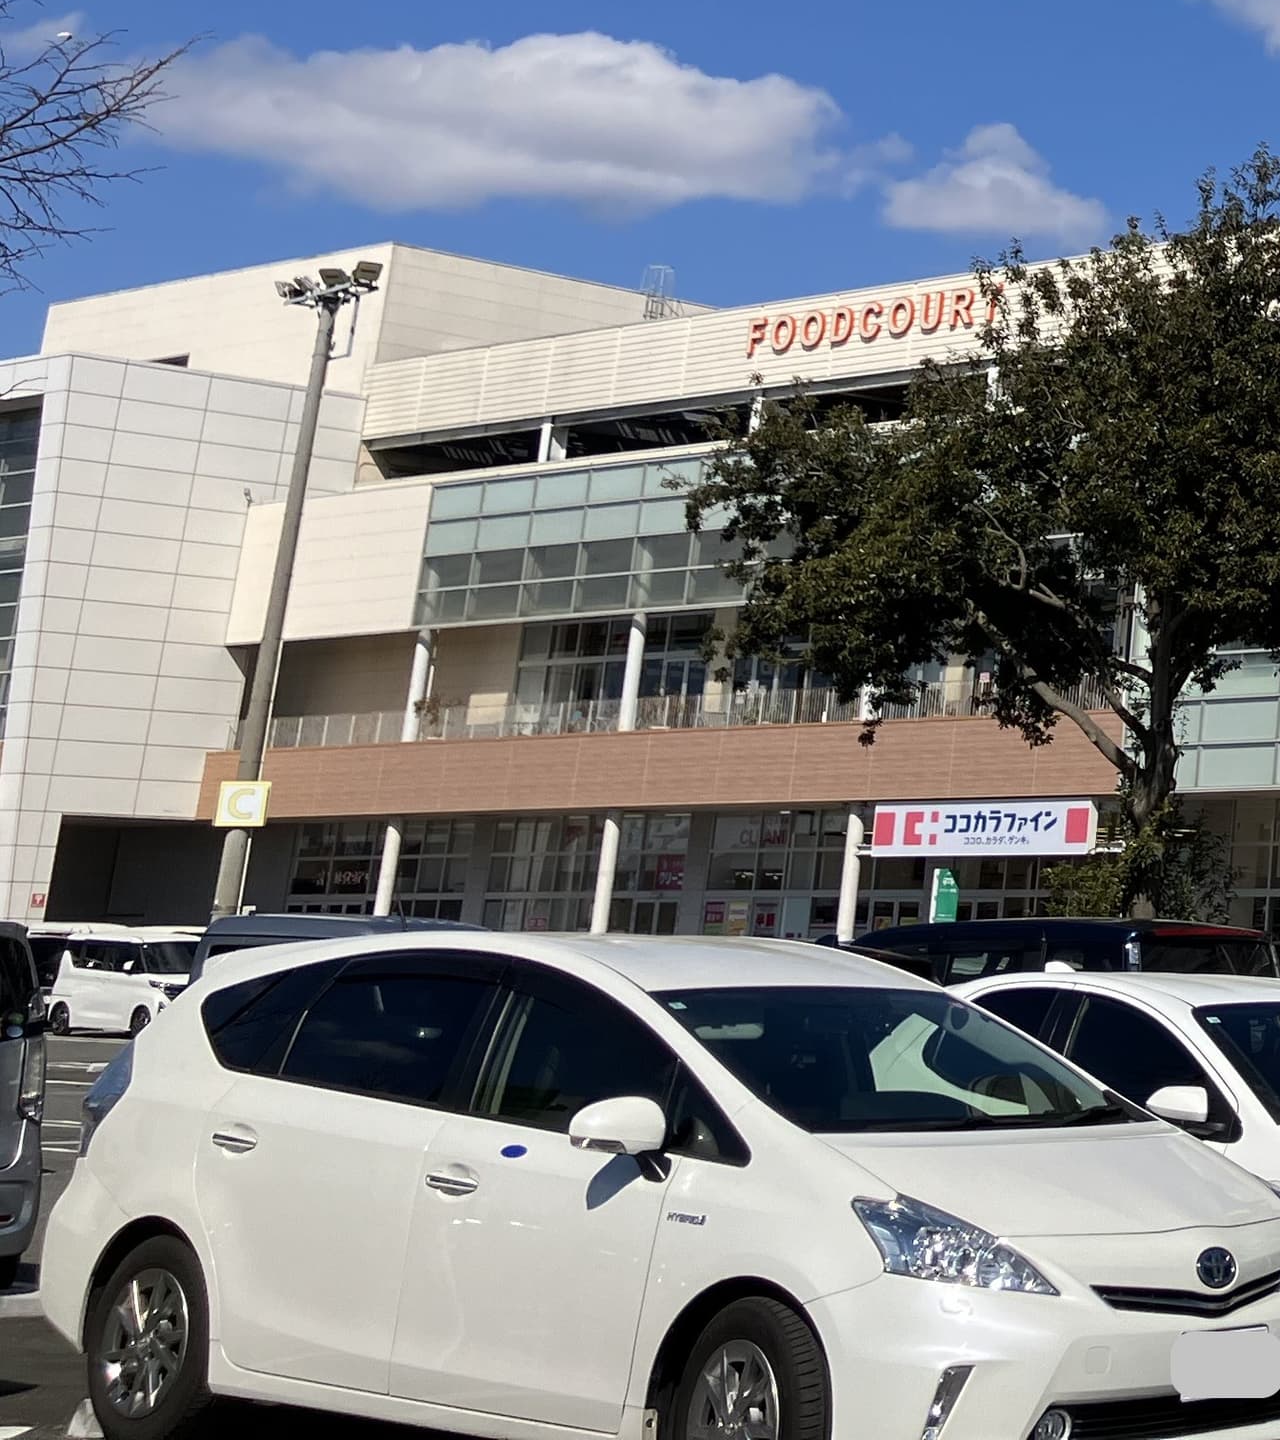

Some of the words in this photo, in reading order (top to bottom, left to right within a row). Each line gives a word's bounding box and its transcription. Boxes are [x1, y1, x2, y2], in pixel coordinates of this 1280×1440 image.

[228, 787, 256, 819] C
[944, 810, 1058, 833] ココカラファイン
